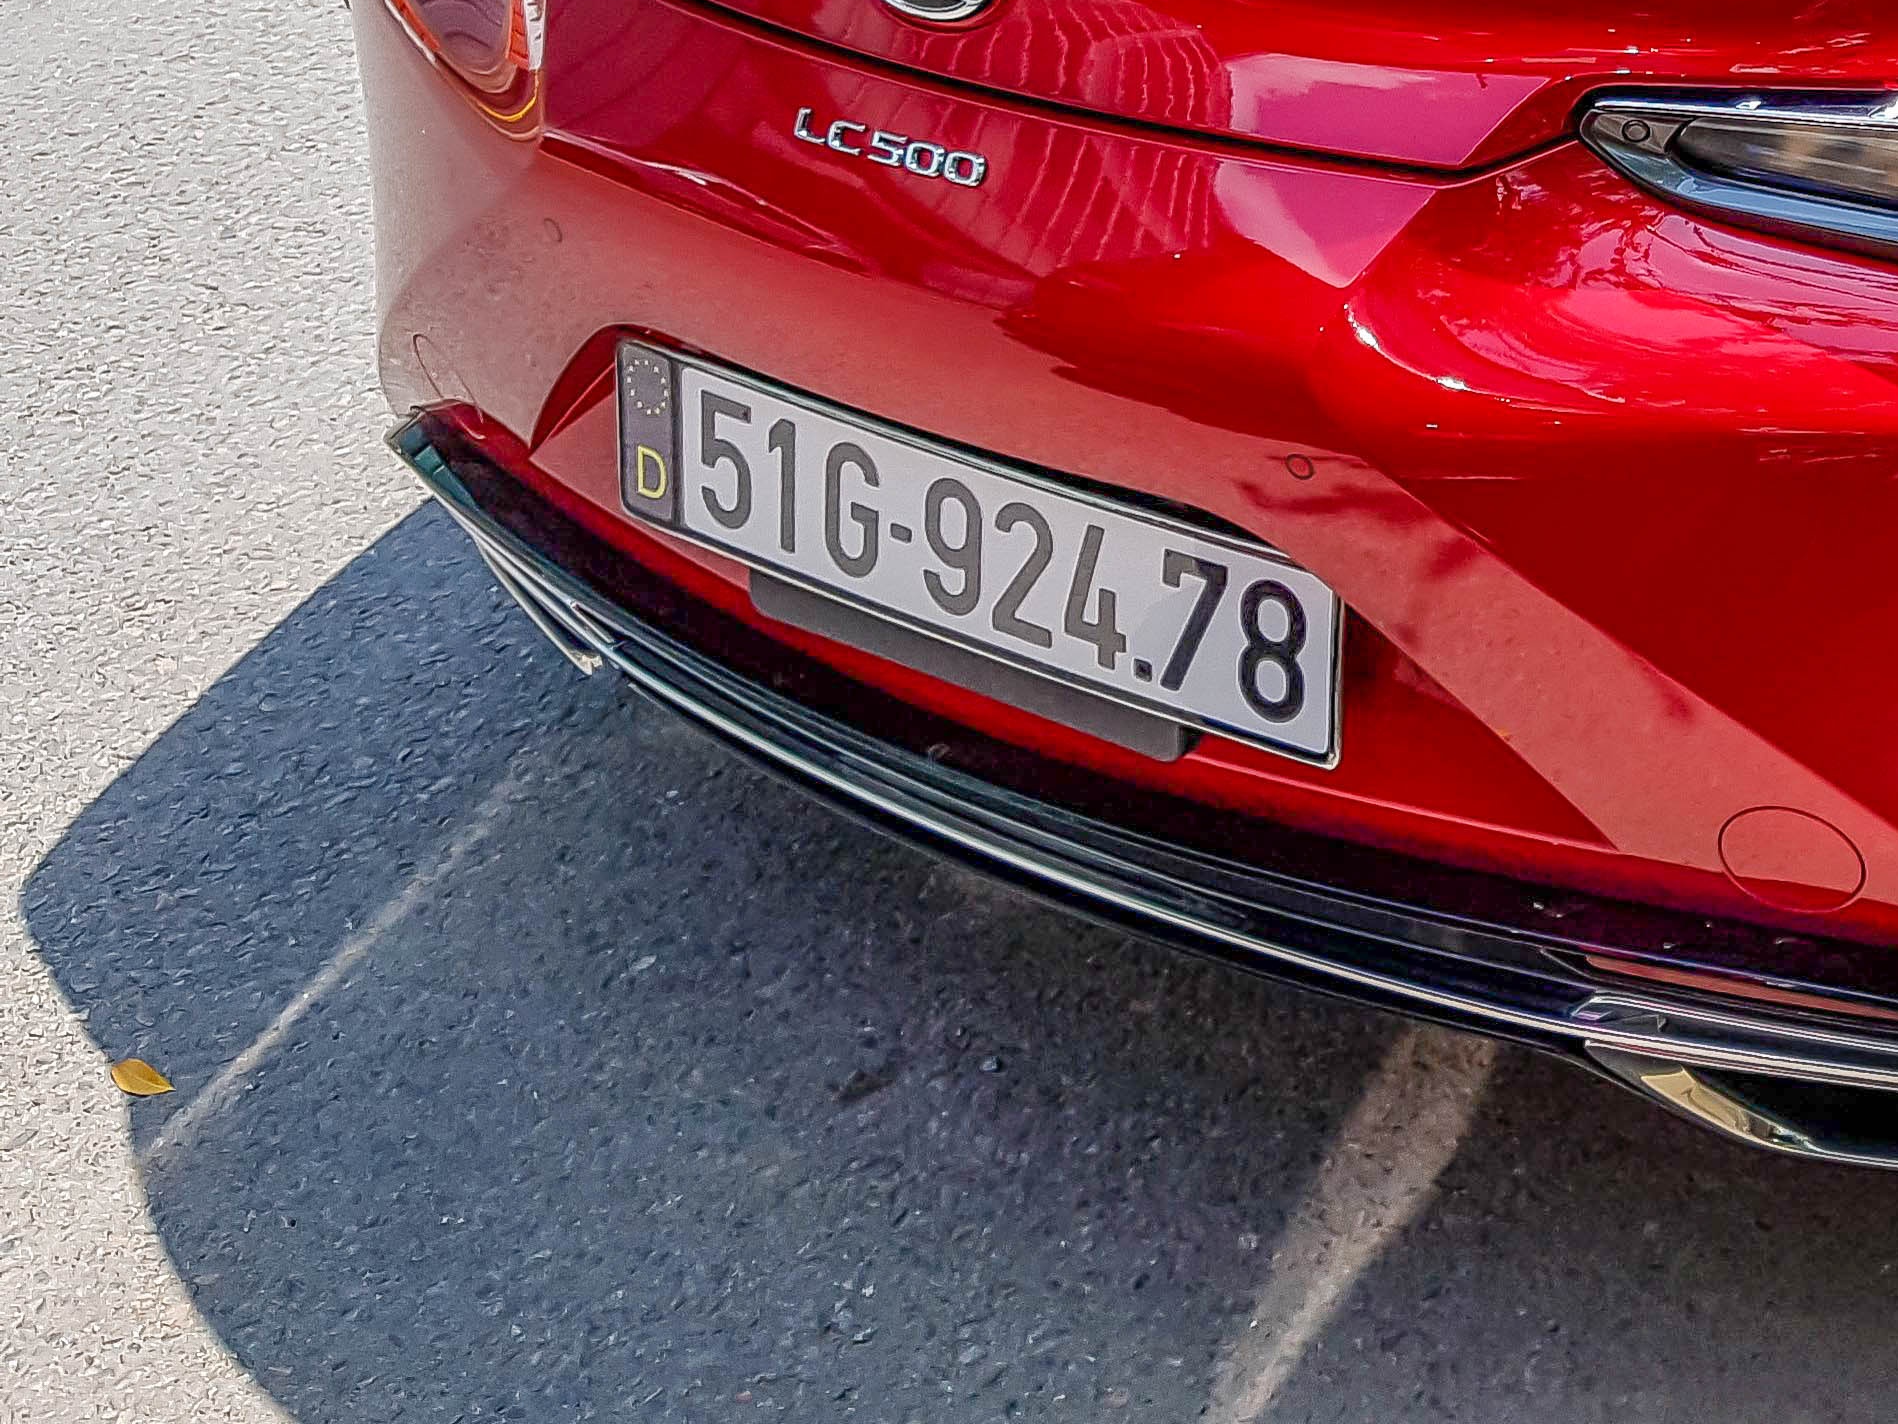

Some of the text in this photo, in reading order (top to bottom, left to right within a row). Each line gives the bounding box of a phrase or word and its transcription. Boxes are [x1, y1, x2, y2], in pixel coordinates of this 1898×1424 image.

[793, 106, 987, 187] LC 500
[636, 445, 669, 500] D
[700, 389, 1308, 724] 51G-924.78
